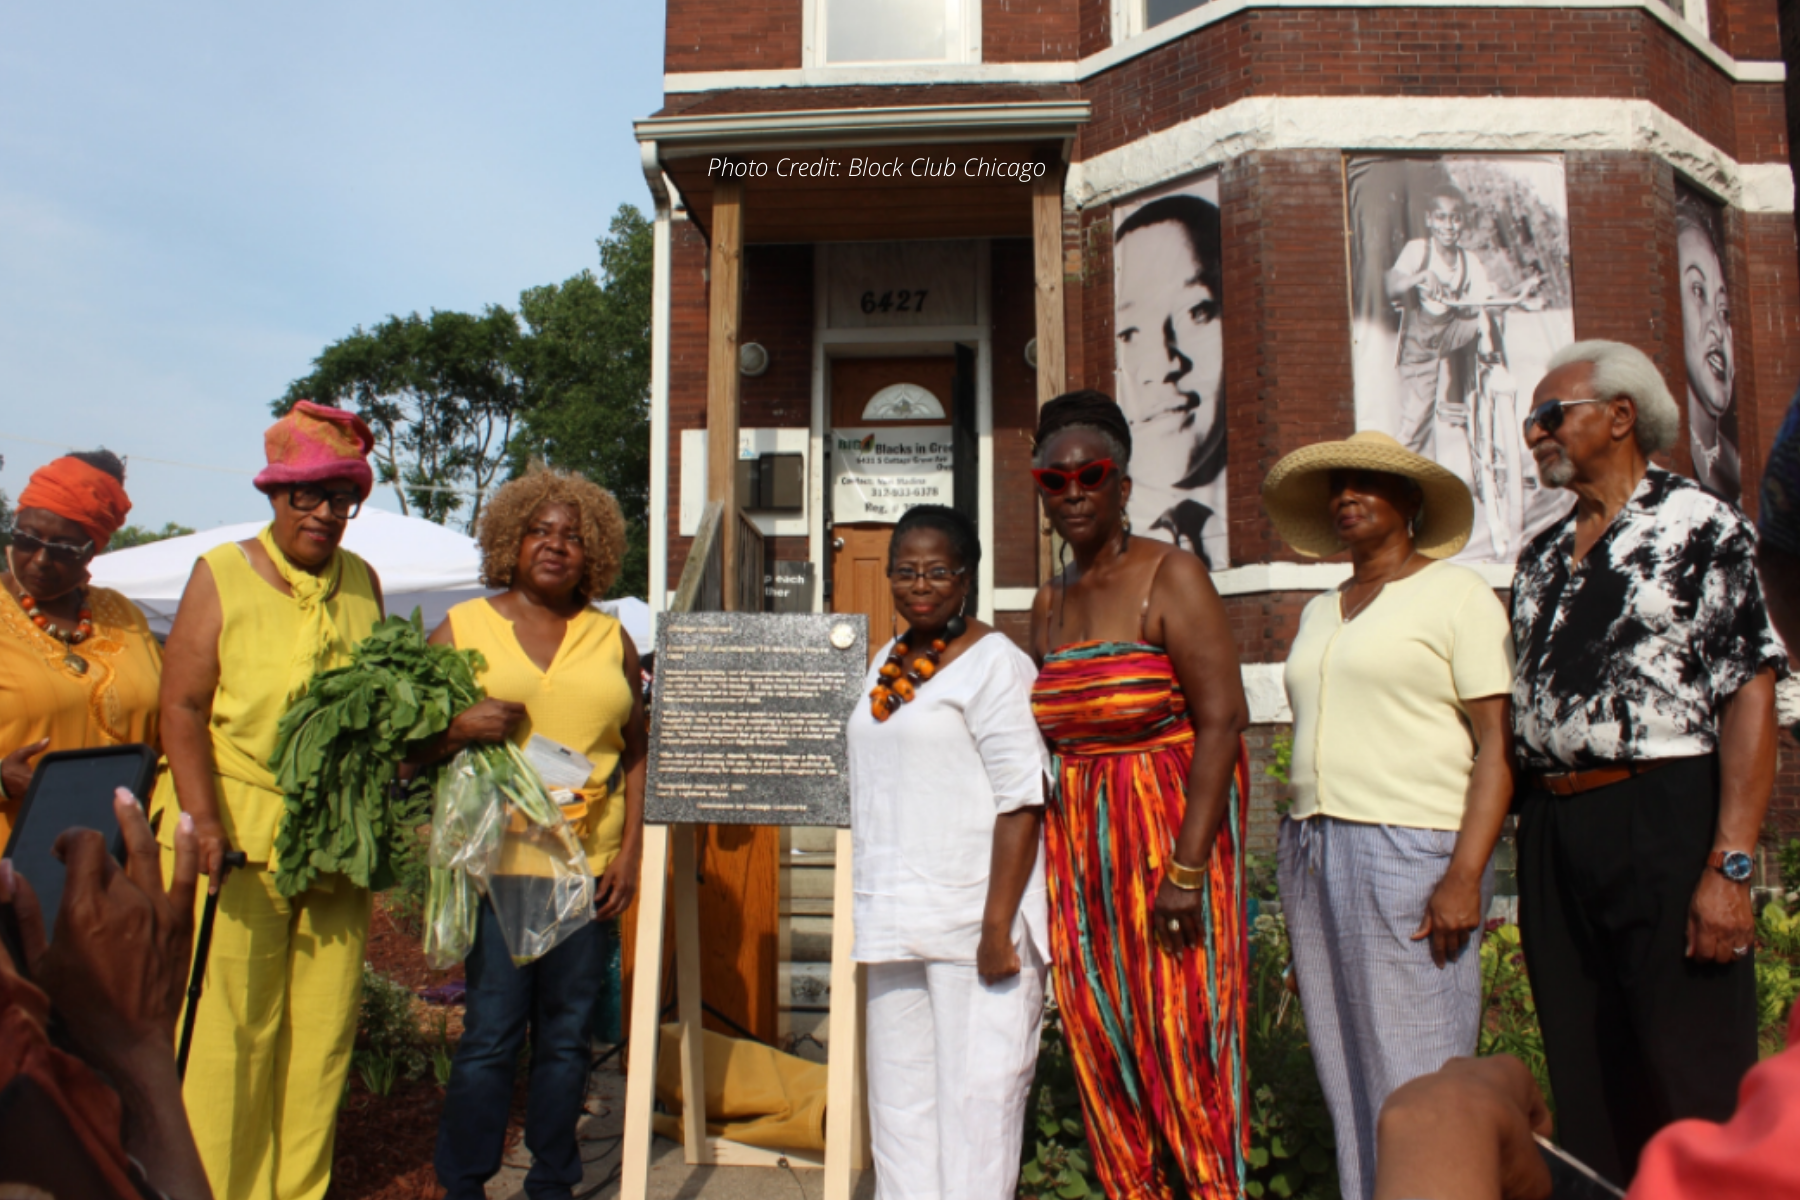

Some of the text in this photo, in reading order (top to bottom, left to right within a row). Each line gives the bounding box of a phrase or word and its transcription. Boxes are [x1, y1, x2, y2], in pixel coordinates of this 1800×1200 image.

[860, 289, 929, 315] 6427
[875, 443, 912, 455] Blacks
[916, 443, 926, 454] in
[775, 573, 804, 585] each
